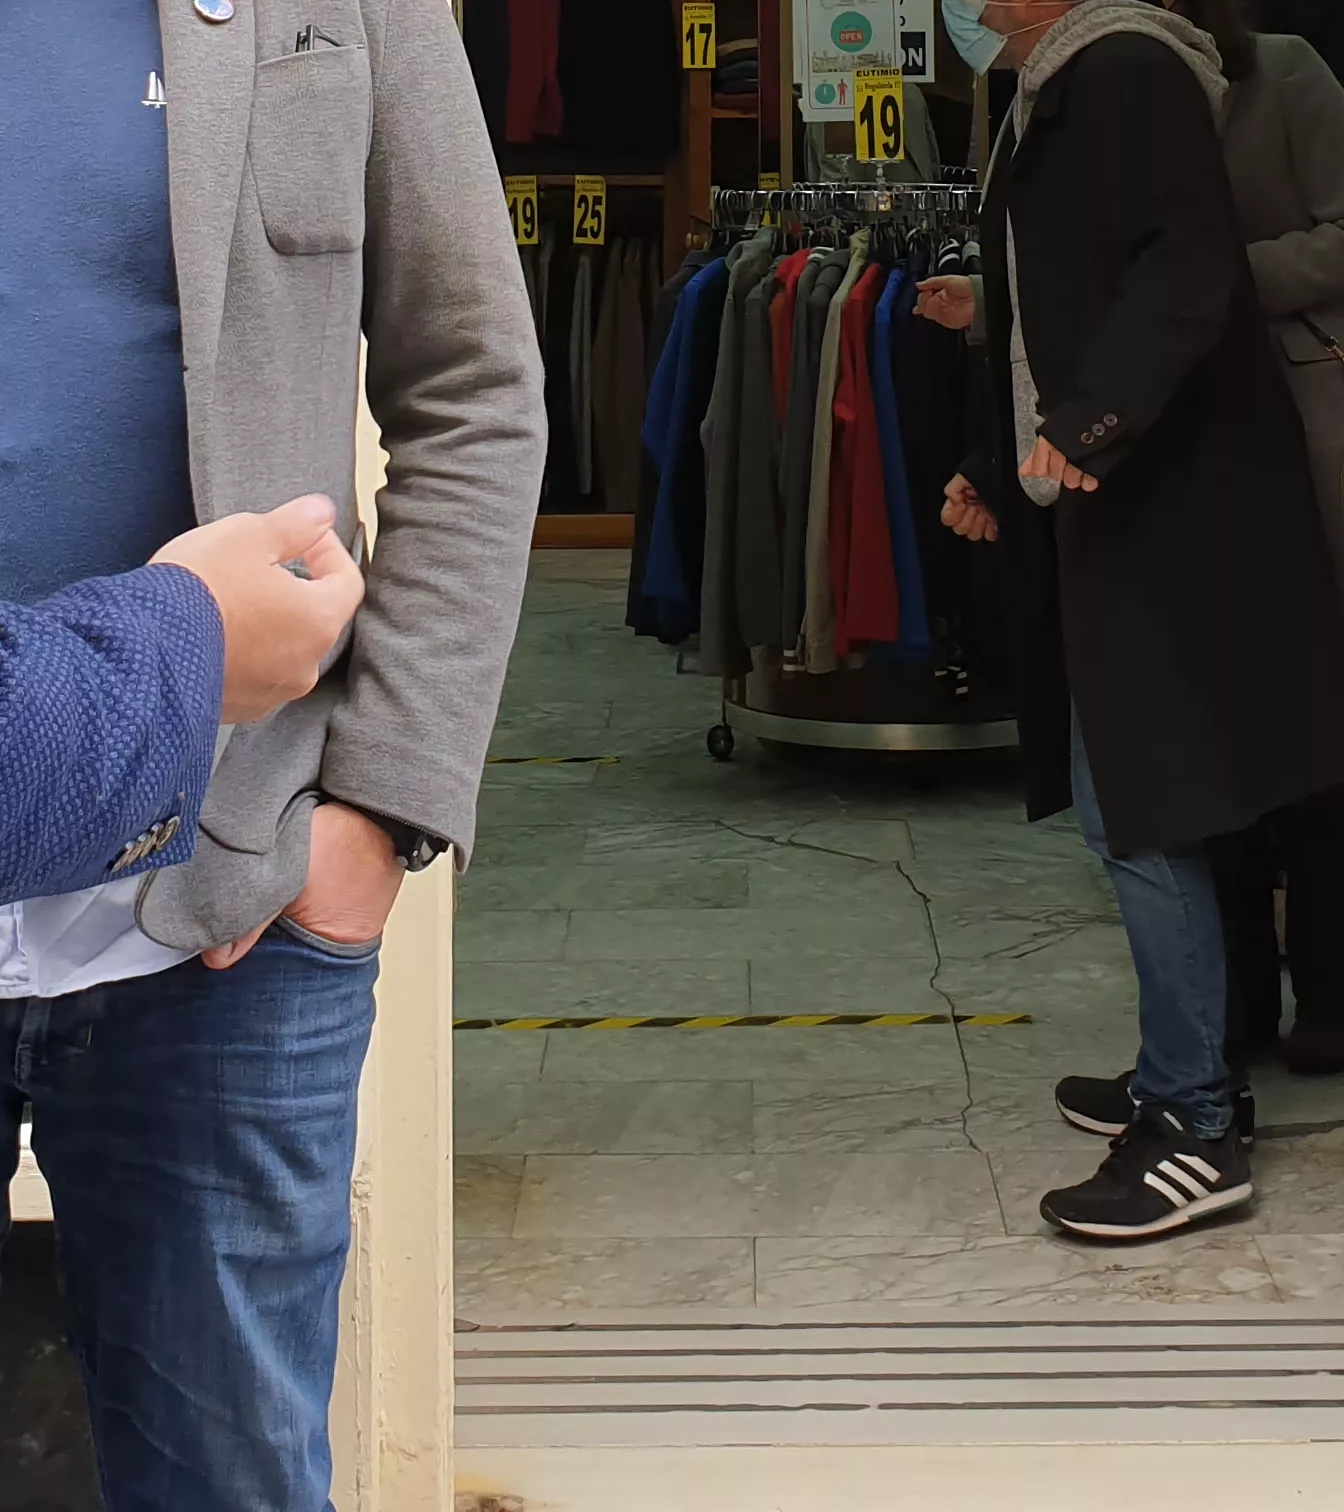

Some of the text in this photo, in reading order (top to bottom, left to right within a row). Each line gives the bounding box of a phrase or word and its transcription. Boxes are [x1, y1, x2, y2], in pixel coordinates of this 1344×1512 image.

[685, 22, 713, 66] 17
[855, 68, 901, 78] EUTIMIO
[859, 94, 902, 159] 19
[509, 196, 536, 240] 19
[575, 194, 604, 240] 25
